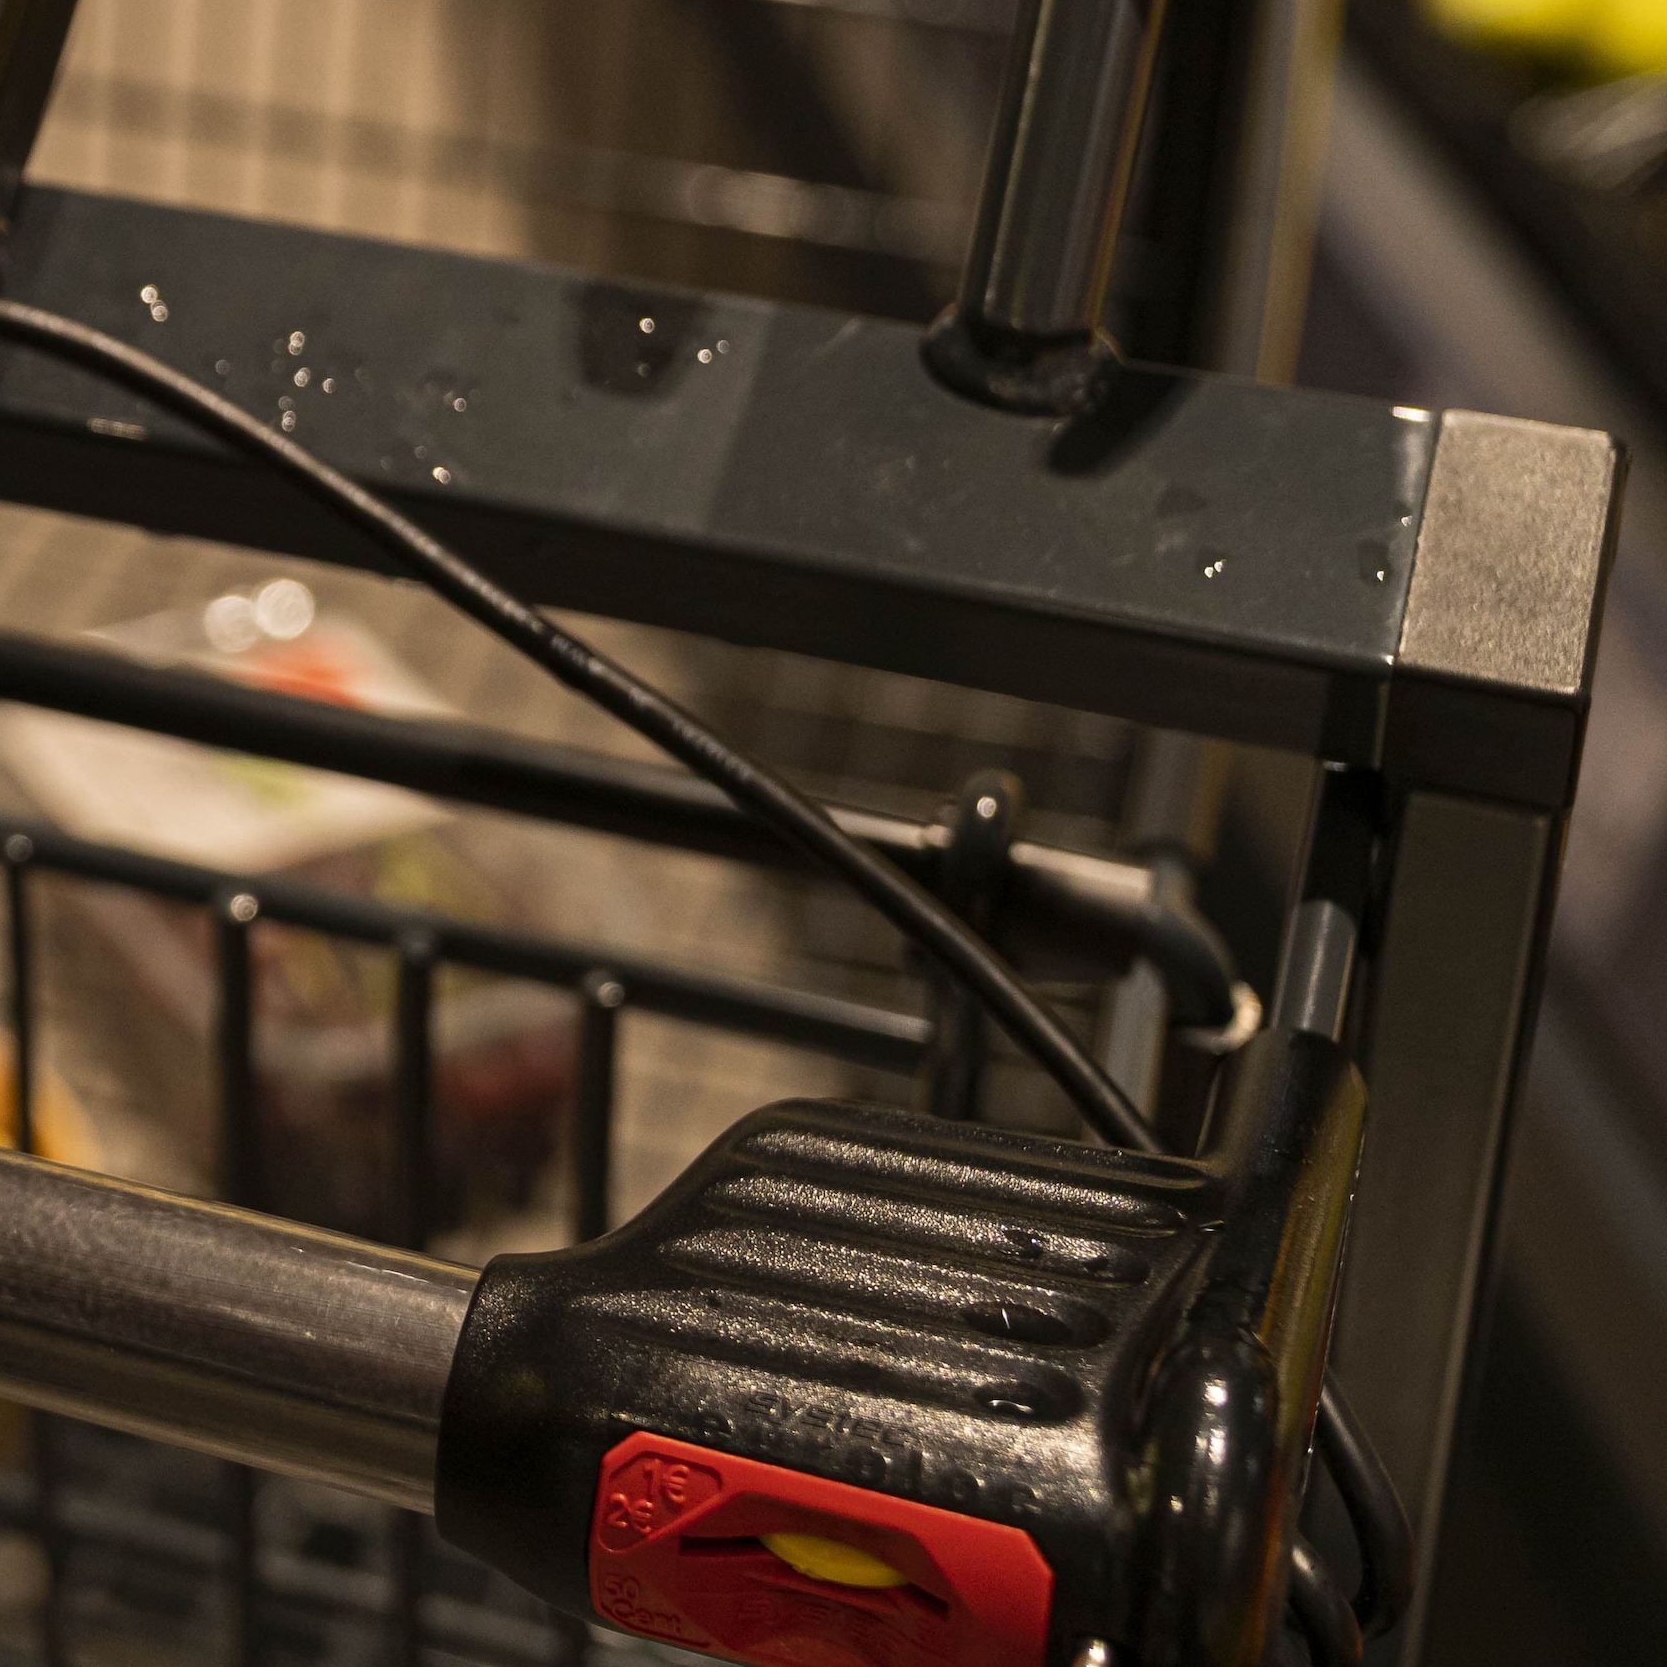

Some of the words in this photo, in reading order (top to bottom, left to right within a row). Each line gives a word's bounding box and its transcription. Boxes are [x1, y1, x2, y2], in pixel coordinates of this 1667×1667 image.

[641, 1457, 692, 1505] 1€
[606, 1490, 655, 1535] 2€
[602, 1570, 643, 1602] 50
[612, 1596, 686, 1637] Cent
